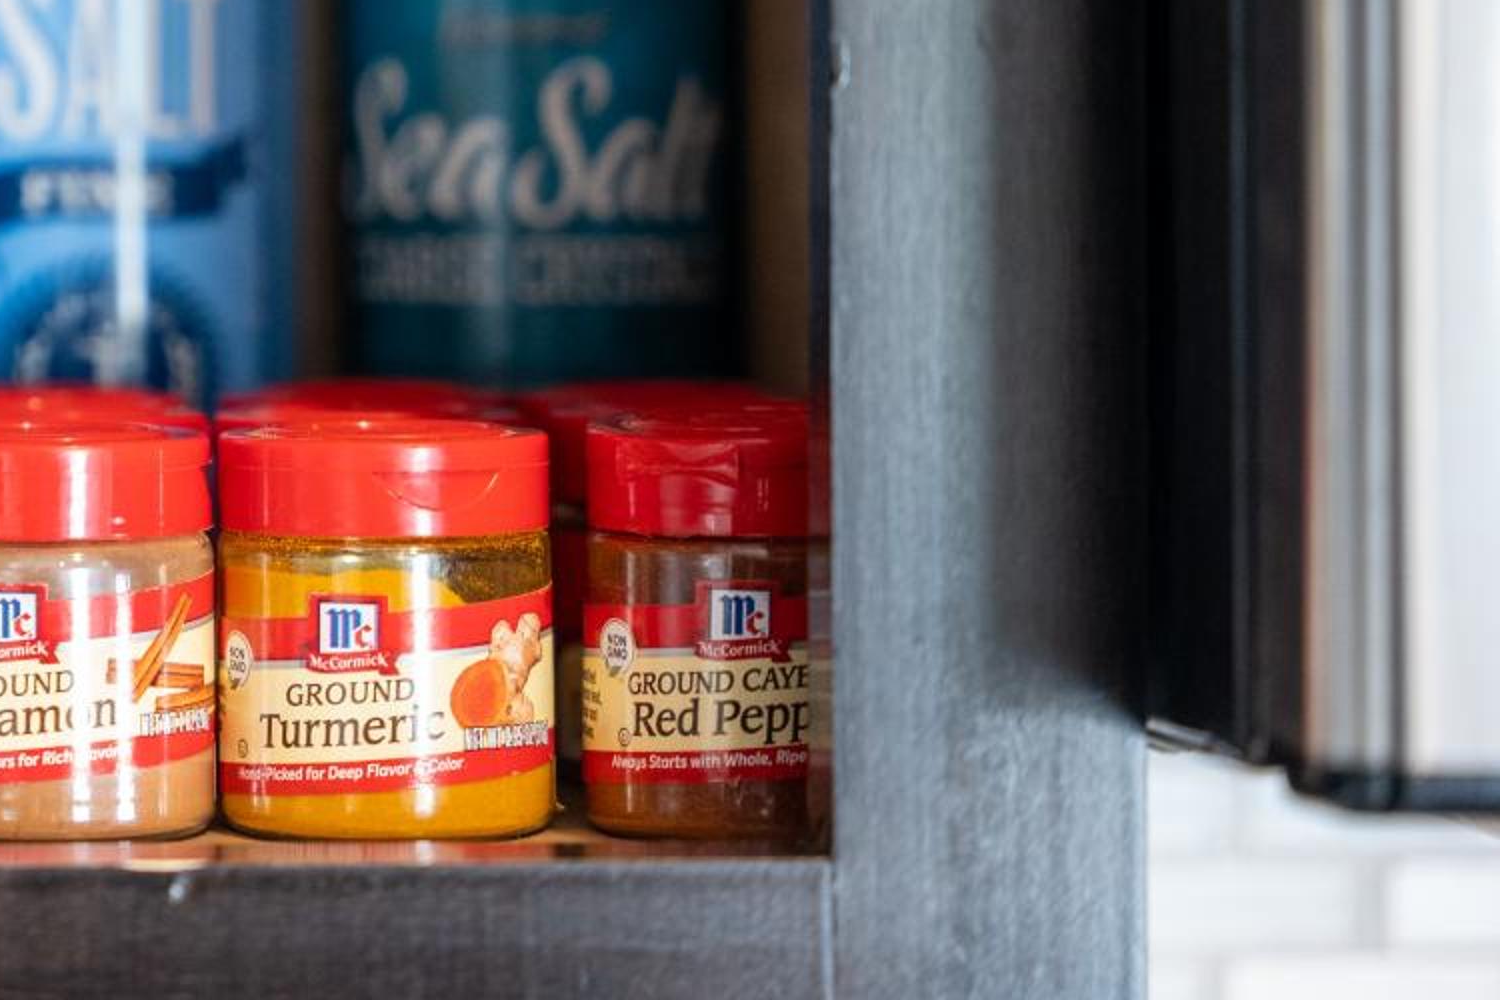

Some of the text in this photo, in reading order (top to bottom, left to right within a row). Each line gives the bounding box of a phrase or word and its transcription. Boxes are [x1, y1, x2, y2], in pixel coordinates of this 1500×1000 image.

[342, 52, 724, 230] Sea Salt
[697, 639, 780, 658] McCormick
[309, 652, 389, 671] McCormick
[285, 677, 416, 707] GROUND
[628, 669, 735, 695] GROUND
[260, 703, 446, 749] Turmeric
[632, 698, 700, 737] Red
[18, 751, 40, 768] for
[41, 747, 74, 766] Rich
[649, 753, 687, 769] Starts
[690, 753, 721, 769] with
[305, 766, 325, 781] for
[327, 764, 363, 783] Deep
[365, 762, 411, 779] Flavor
